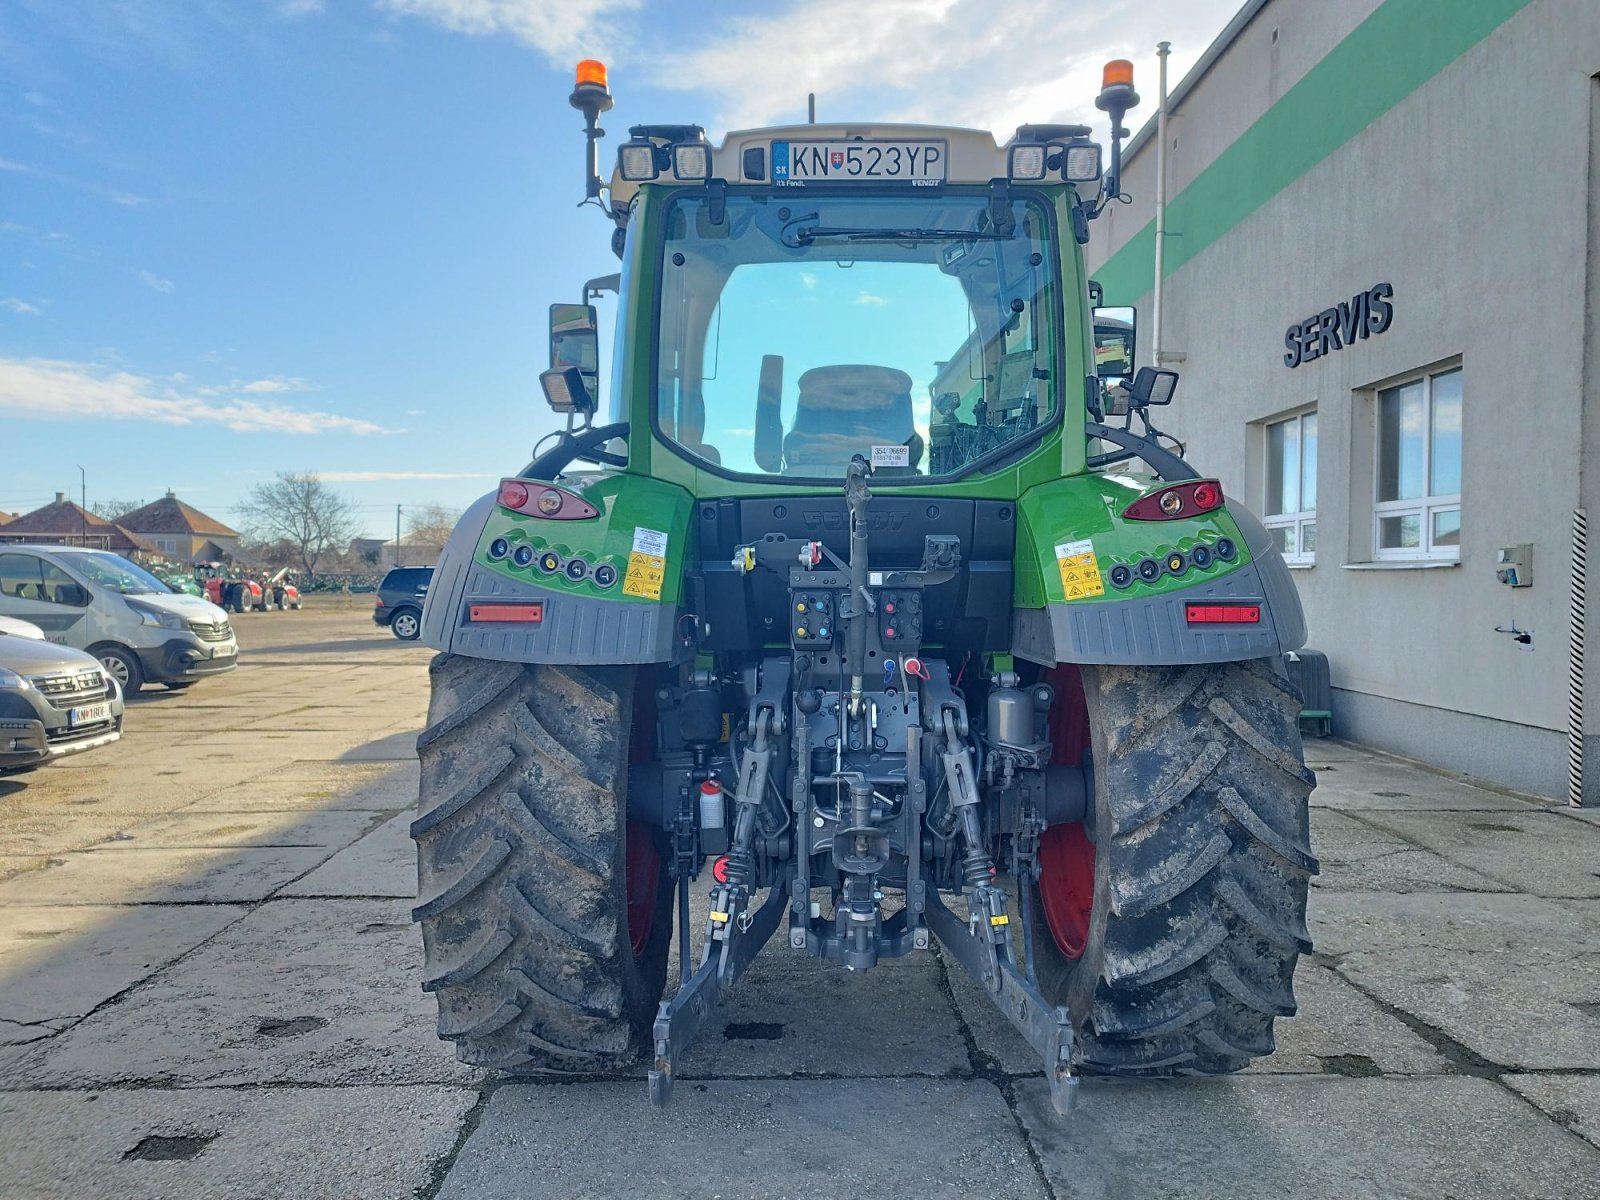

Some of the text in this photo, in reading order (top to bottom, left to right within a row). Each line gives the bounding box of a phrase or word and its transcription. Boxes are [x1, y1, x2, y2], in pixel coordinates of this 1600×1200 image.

[775, 165, 787, 175] SK
[793, 147, 940, 176] KN 523YP
[911, 179, 941, 187] FENDT
[1283, 282, 1394, 369] SERVIS
[802, 510, 911, 531] FEDT
